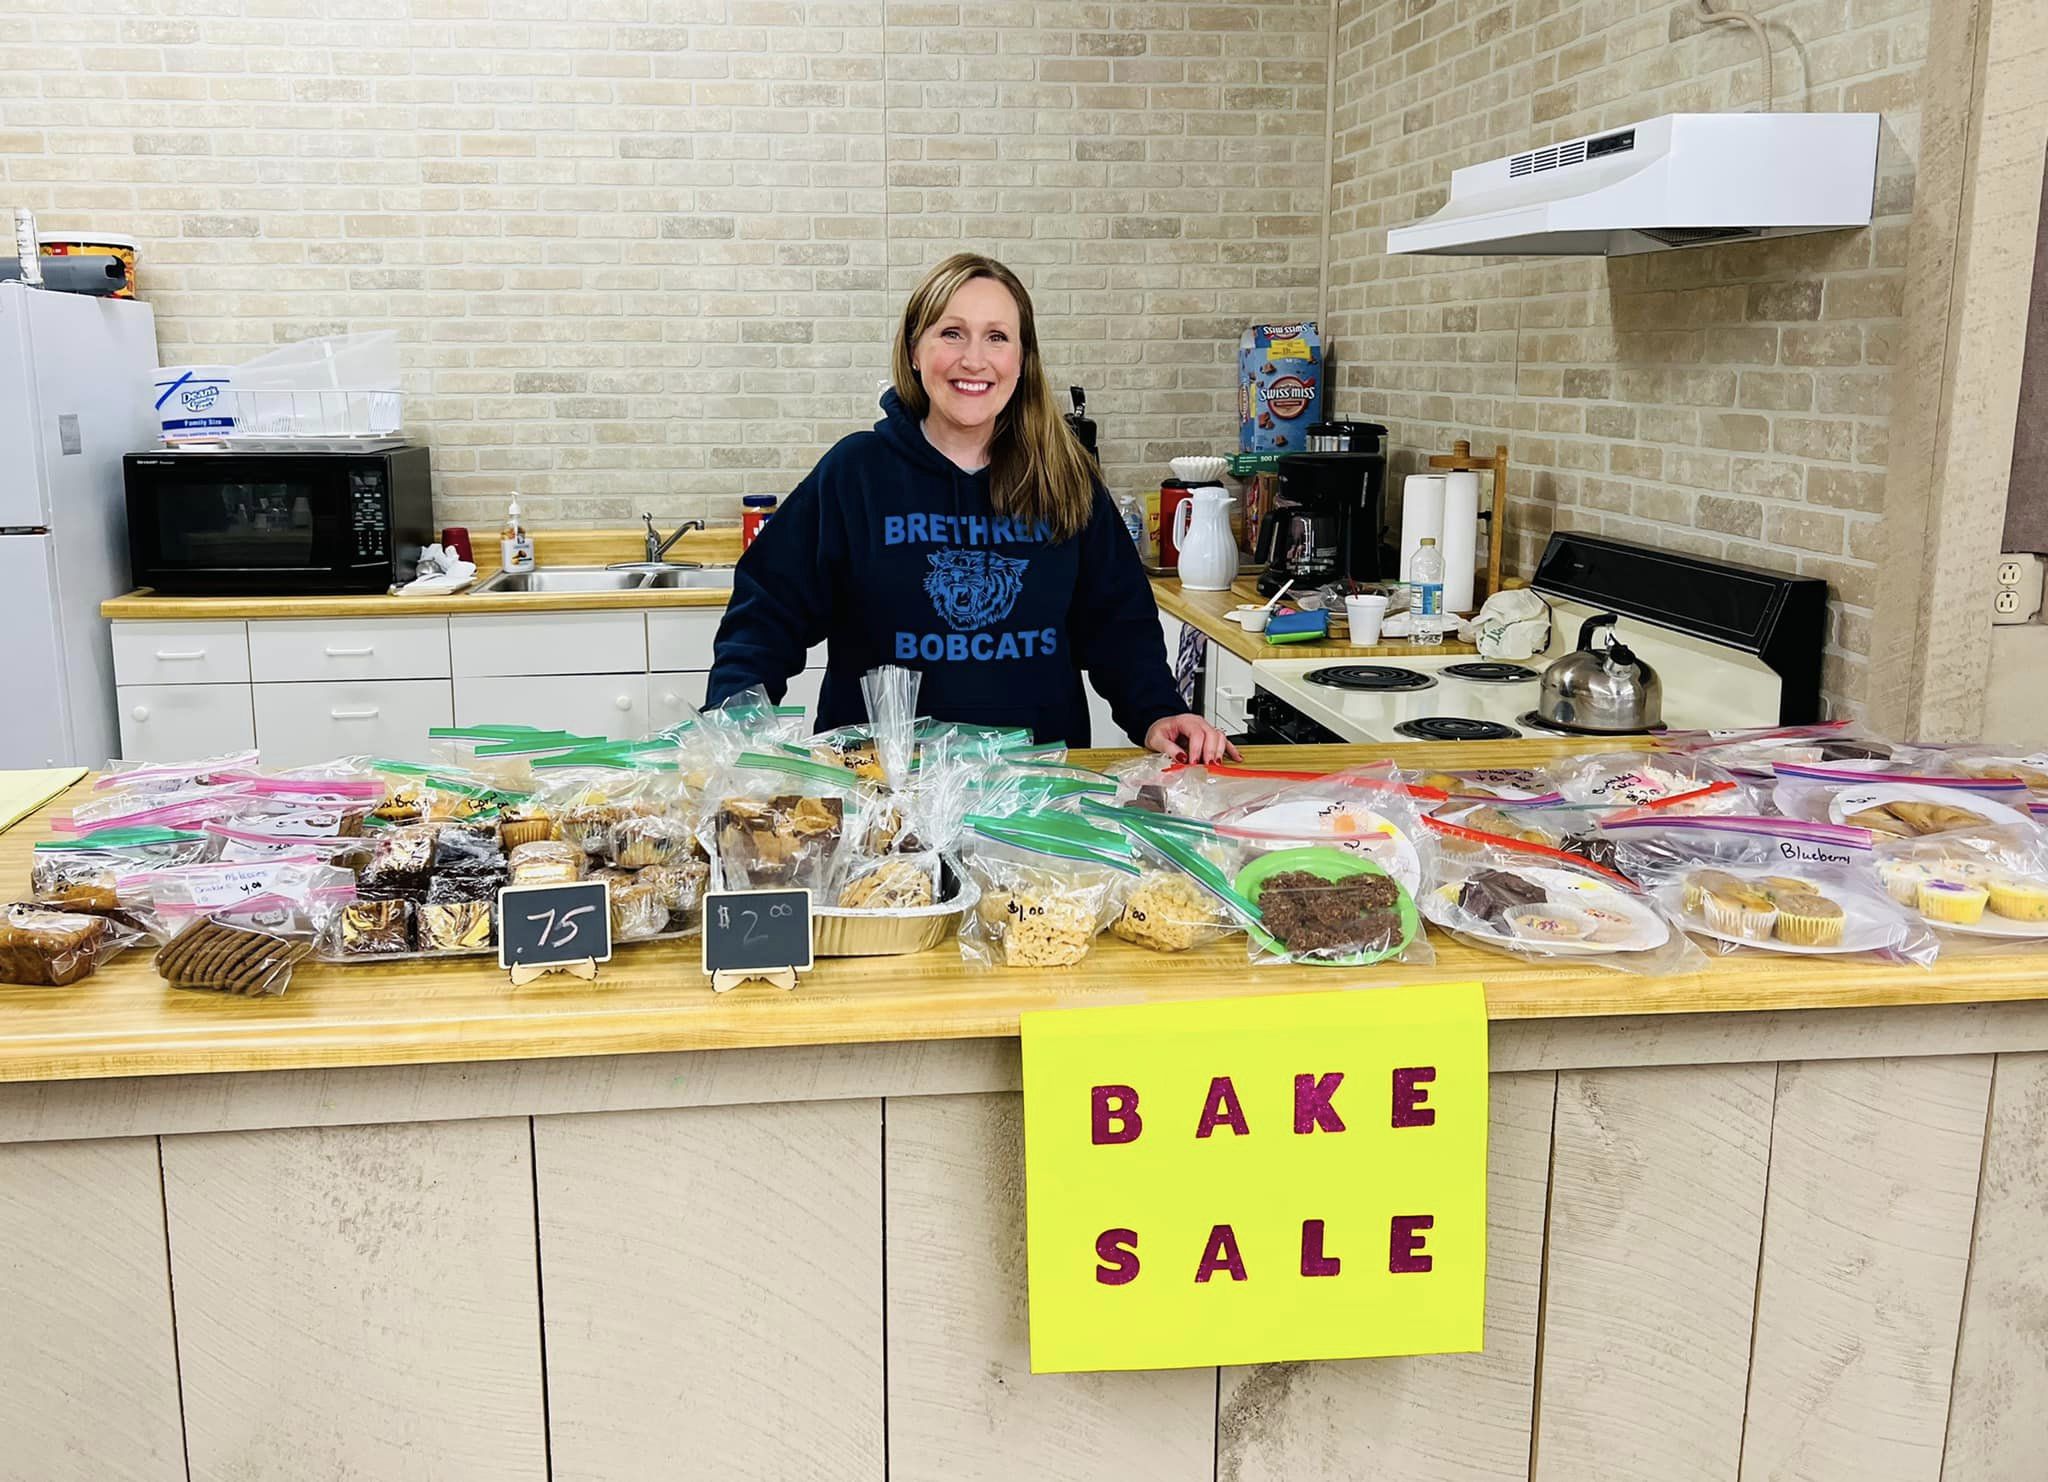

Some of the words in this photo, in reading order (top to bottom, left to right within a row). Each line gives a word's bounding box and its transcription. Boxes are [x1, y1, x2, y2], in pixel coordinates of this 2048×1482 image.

[895, 627, 1057, 661] BOBCATS
[1091, 1066, 1436, 1145] BAKE
[1094, 1215, 1434, 1286] SALE
